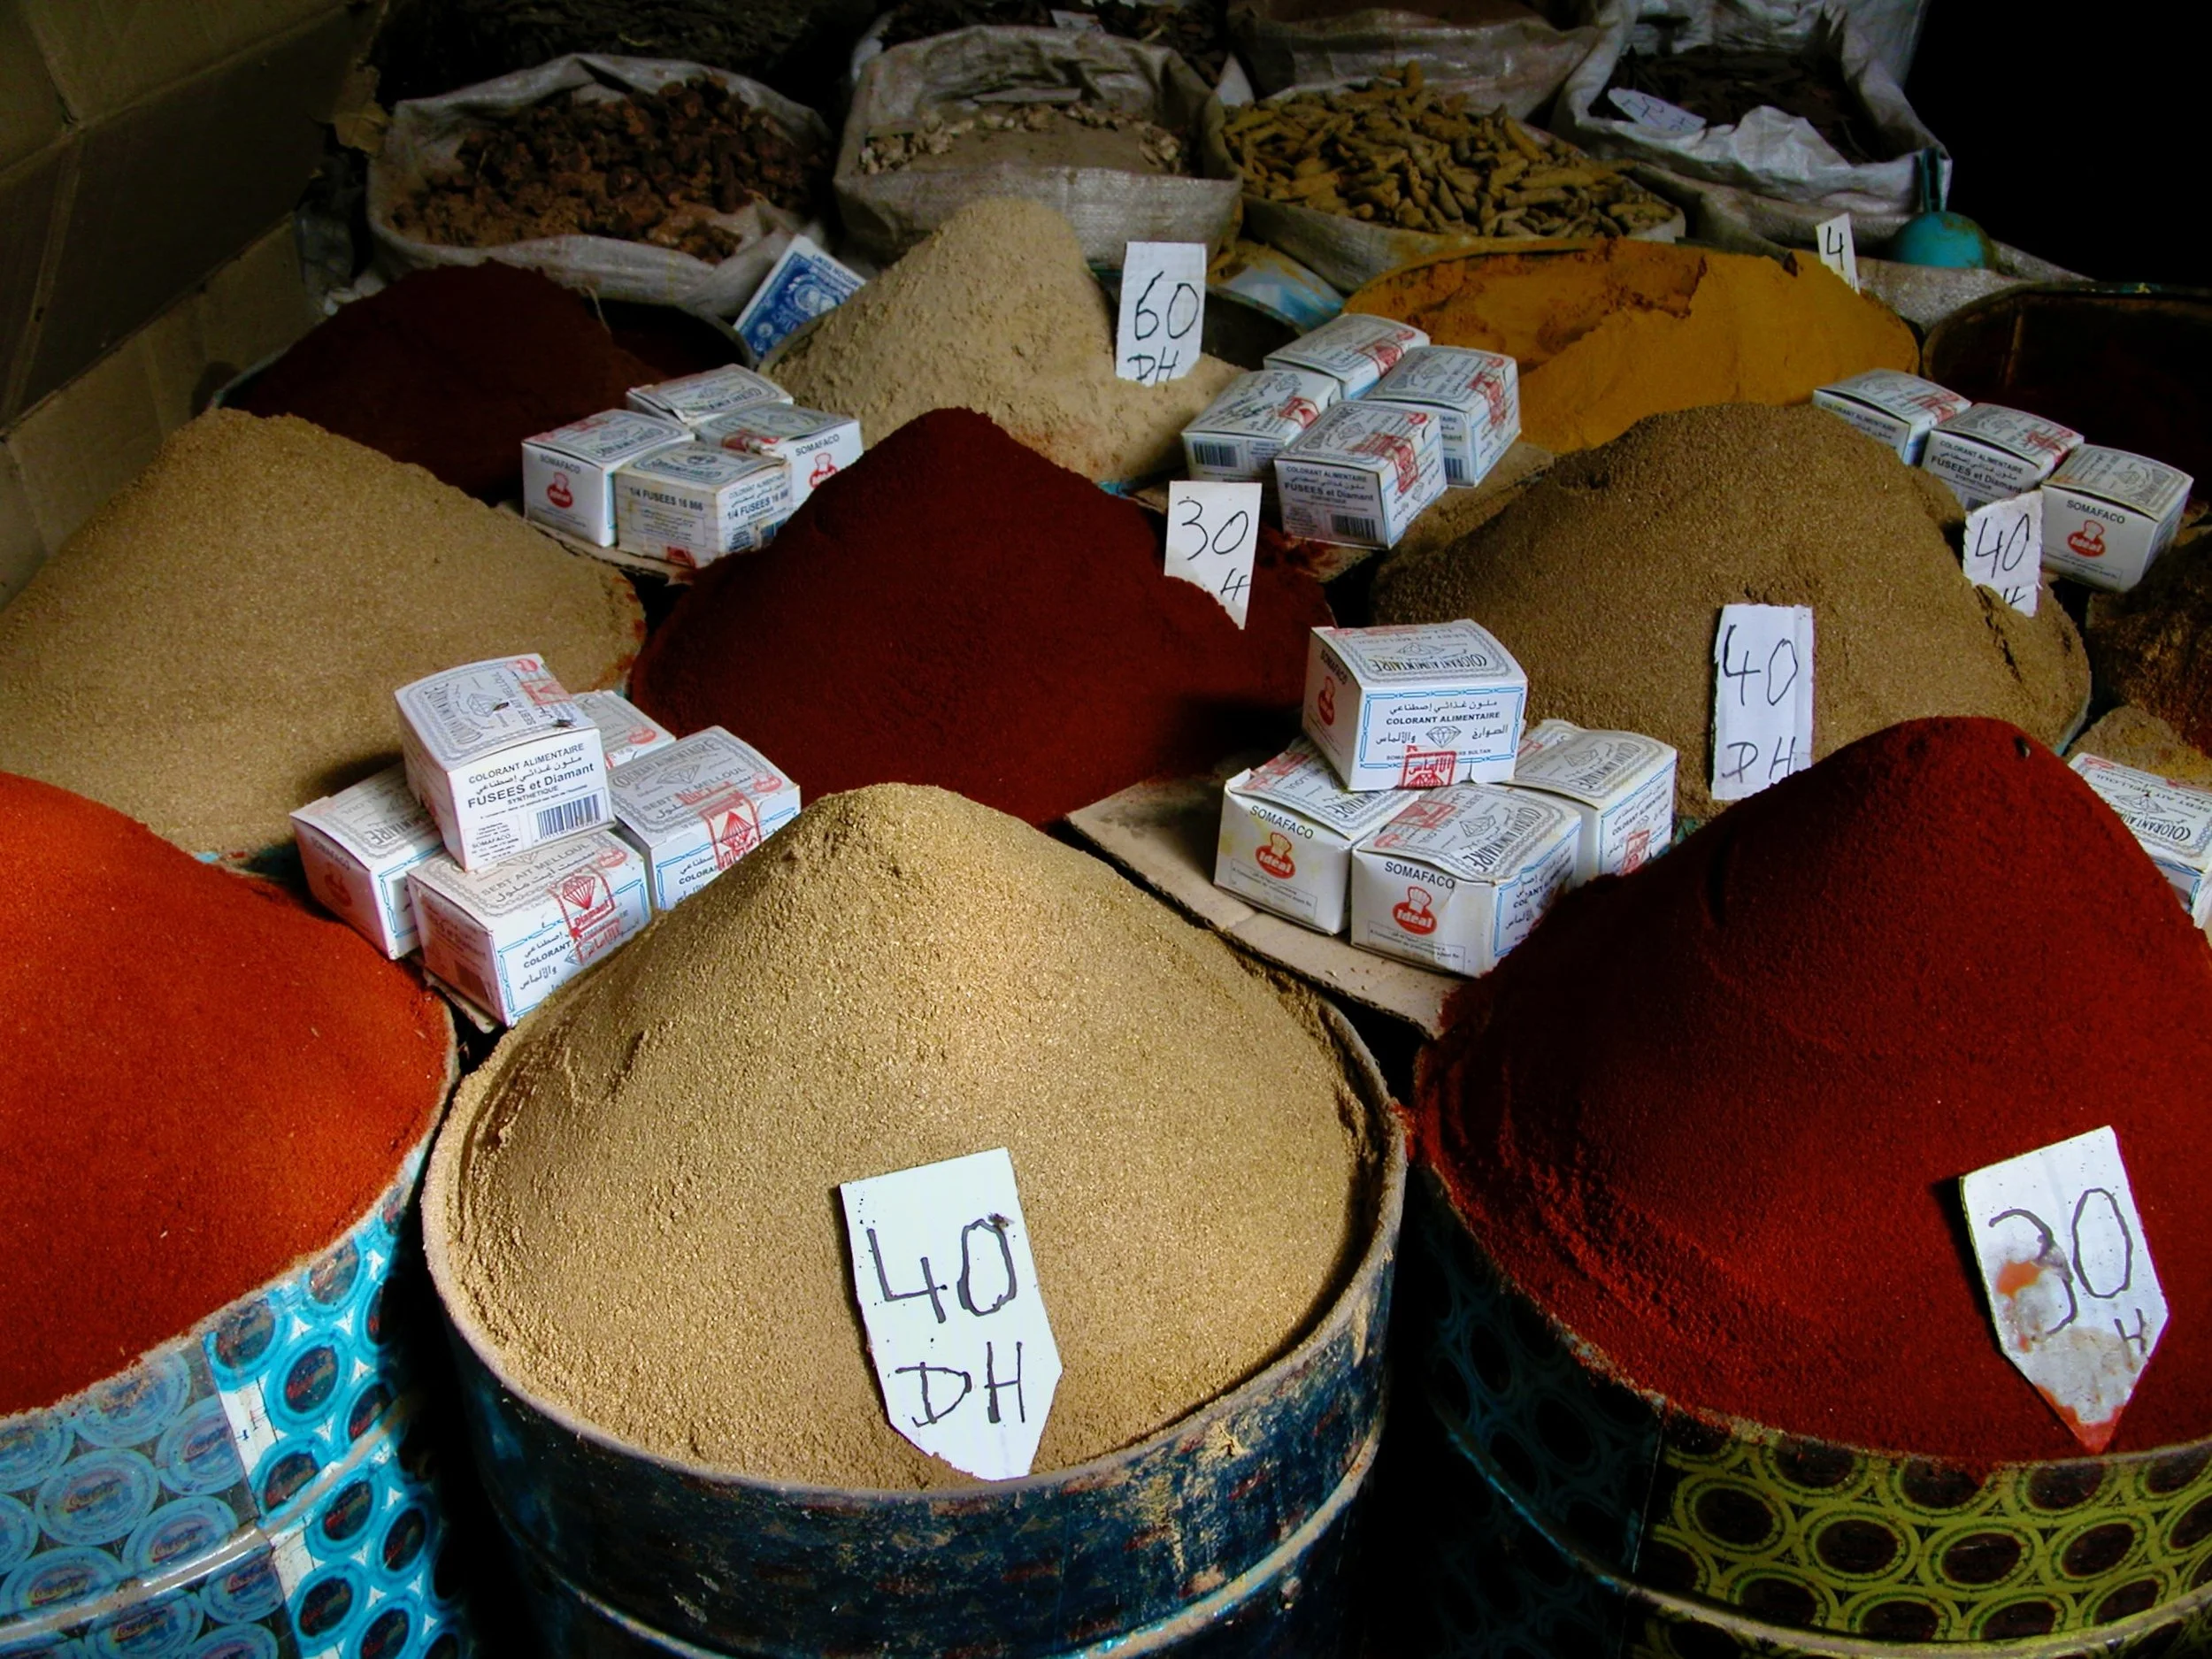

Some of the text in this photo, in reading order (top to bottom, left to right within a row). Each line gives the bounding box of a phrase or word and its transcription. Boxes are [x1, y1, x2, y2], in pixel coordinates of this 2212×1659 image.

[1135, 271, 1200, 341] 60
[1126, 346, 1179, 383] DH
[795, 434, 840, 457] SOMAFACO
[1939, 440, 1978, 457] COLORANT
[539, 453, 581, 475] SOMAFACO
[1286, 465, 1322, 476] COLORANT
[1931, 455, 2023, 494] FUSEES et Diamant
[642, 488, 676, 506] FUSEES
[726, 509, 739, 520] 1/4
[740, 495, 771, 516] FUSEES
[1284, 482, 1324, 496] FUSEES
[1325, 488, 1335, 497] et
[1336, 487, 1373, 501] Diamant
[1178, 499, 1249, 561] 30
[2067, 499, 2126, 525] SOMAFACO
[1975, 513, 2031, 580] 40
[1722, 624, 1799, 707] 40
[1386, 710, 1501, 726] COLORANT ALIMENTAIRE
[468, 742, 586, 784] COLORANT ALIMENTAIRE
[1721, 735, 1796, 783] DH
[467, 763, 595, 809] FUSEES et Diamant
[507, 785, 559, 805] SYNTHETIQUE
[641, 796, 669, 813] SEBT
[695, 765, 747, 794] MELLOUL
[1249, 804, 1314, 840] SOMAFACO
[480, 880, 512, 897] SEBT
[516, 869, 533, 880] AIT
[534, 842, 589, 872] MELLOUL
[1384, 861, 1456, 890] SOMAFACO
[523, 940, 572, 968] COLORANT
[866, 1218, 1018, 1323] 40
[894, 1341, 1026, 1426] DH
